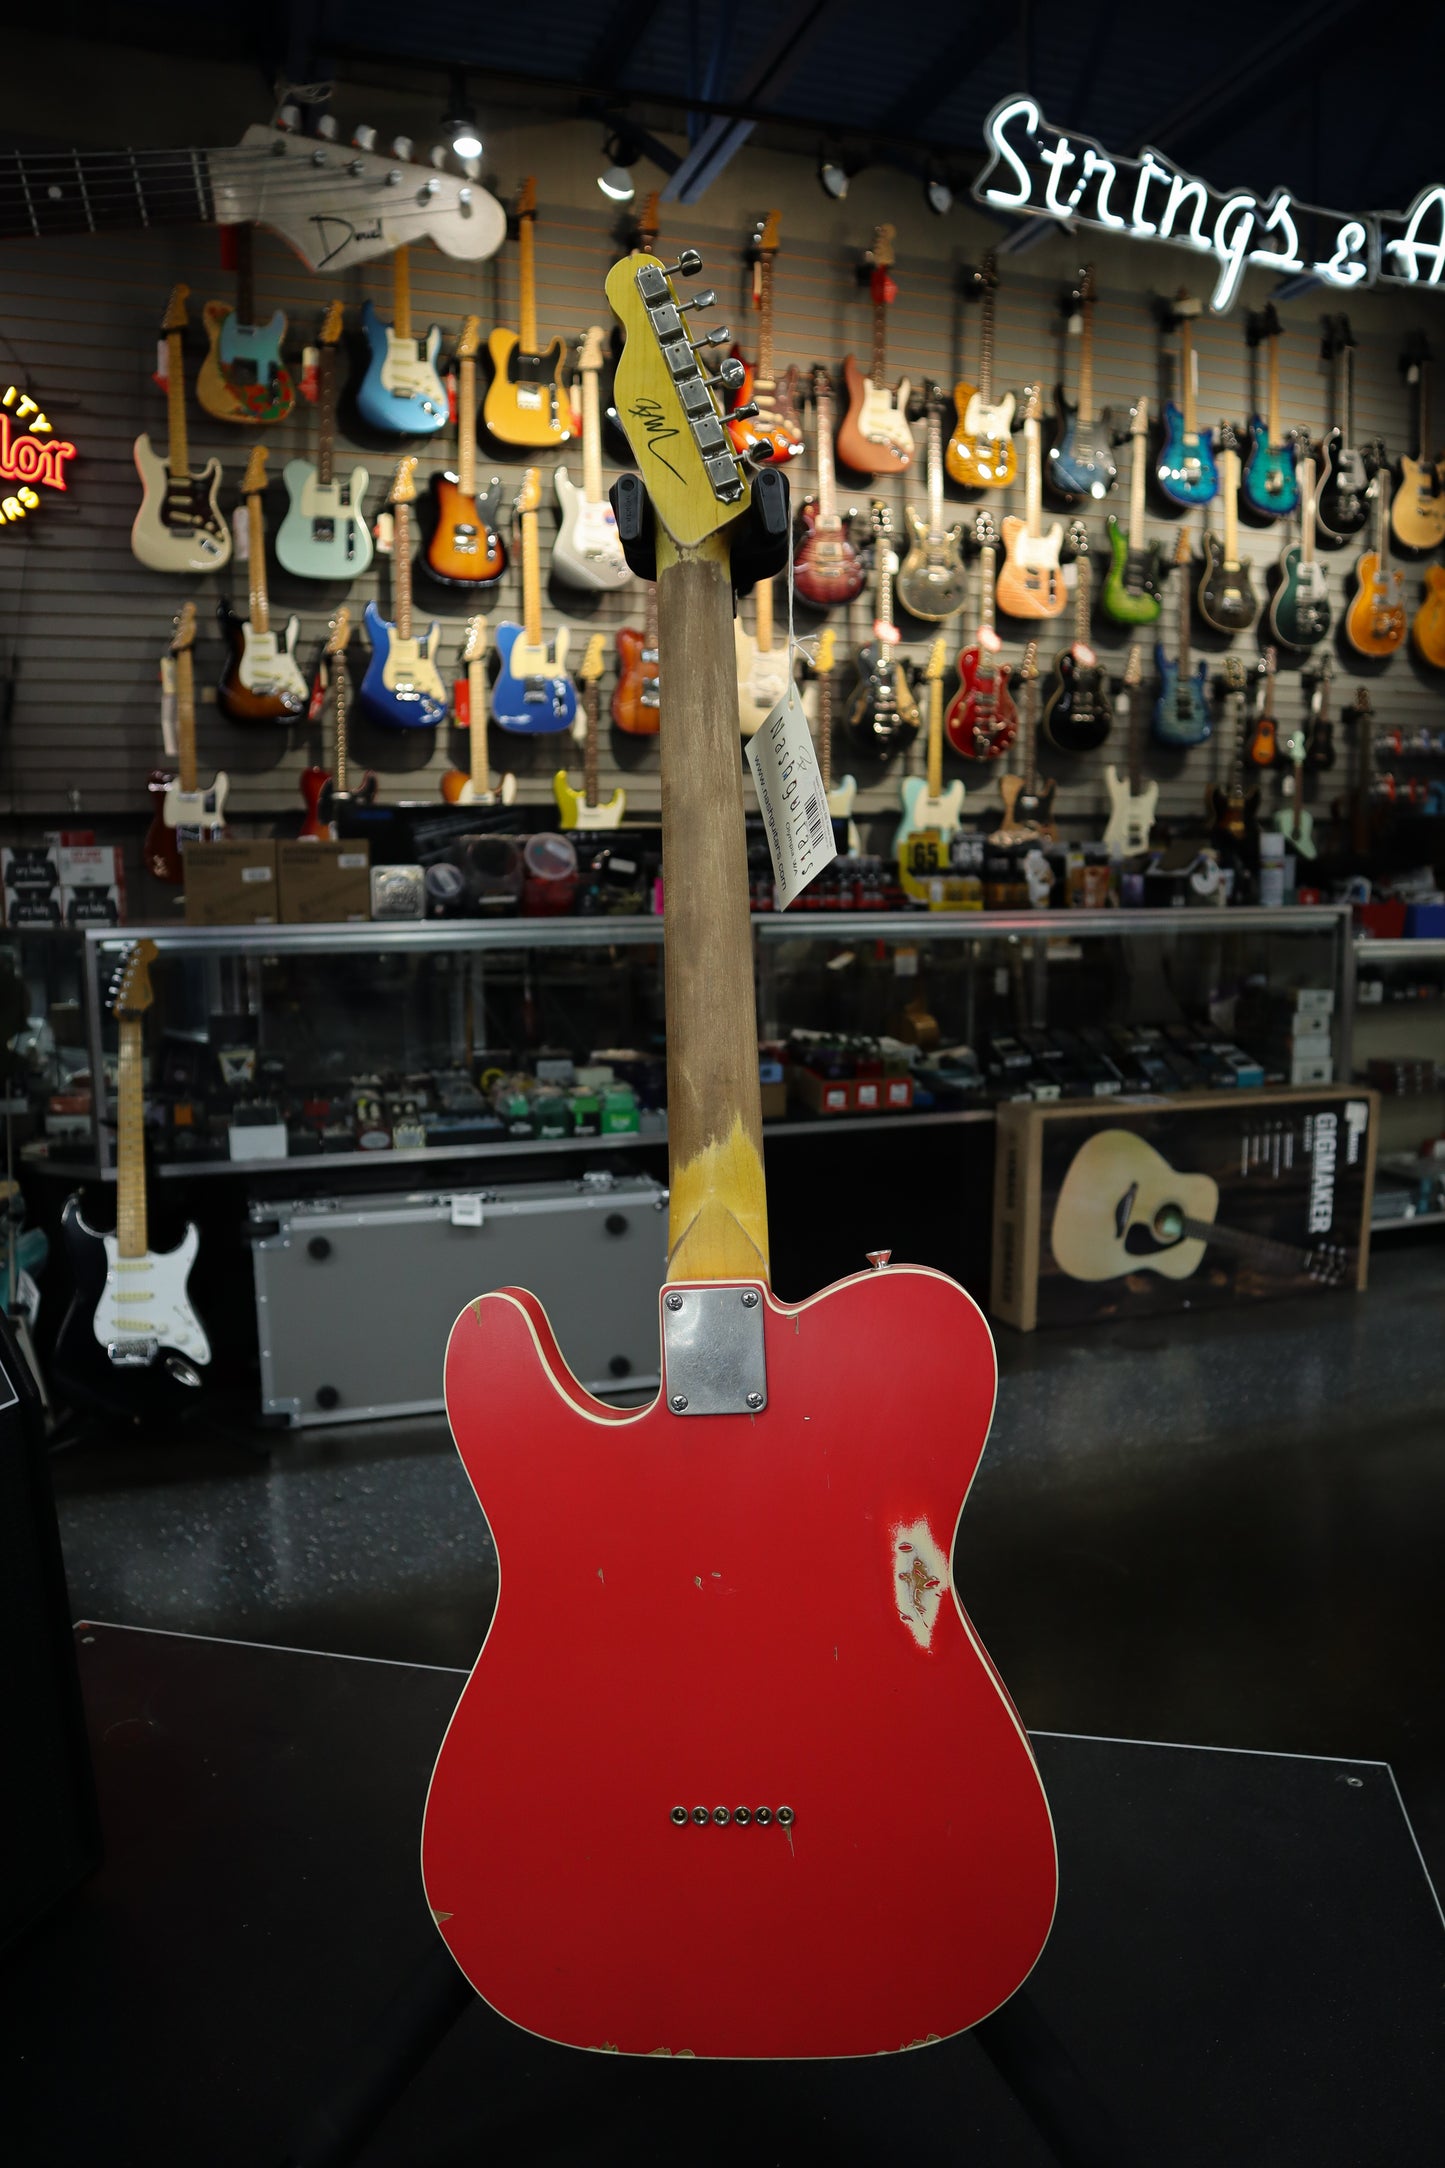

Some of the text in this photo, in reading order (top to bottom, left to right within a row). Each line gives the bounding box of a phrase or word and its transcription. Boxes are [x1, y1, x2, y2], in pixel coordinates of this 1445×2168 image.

[986, 100, 1304, 311] Strings
[1314, 221, 1366, 286] &
[755, 754, 788, 892] www.nashguitars.com
[1308, 1112, 1338, 1234] GIGMAKER
